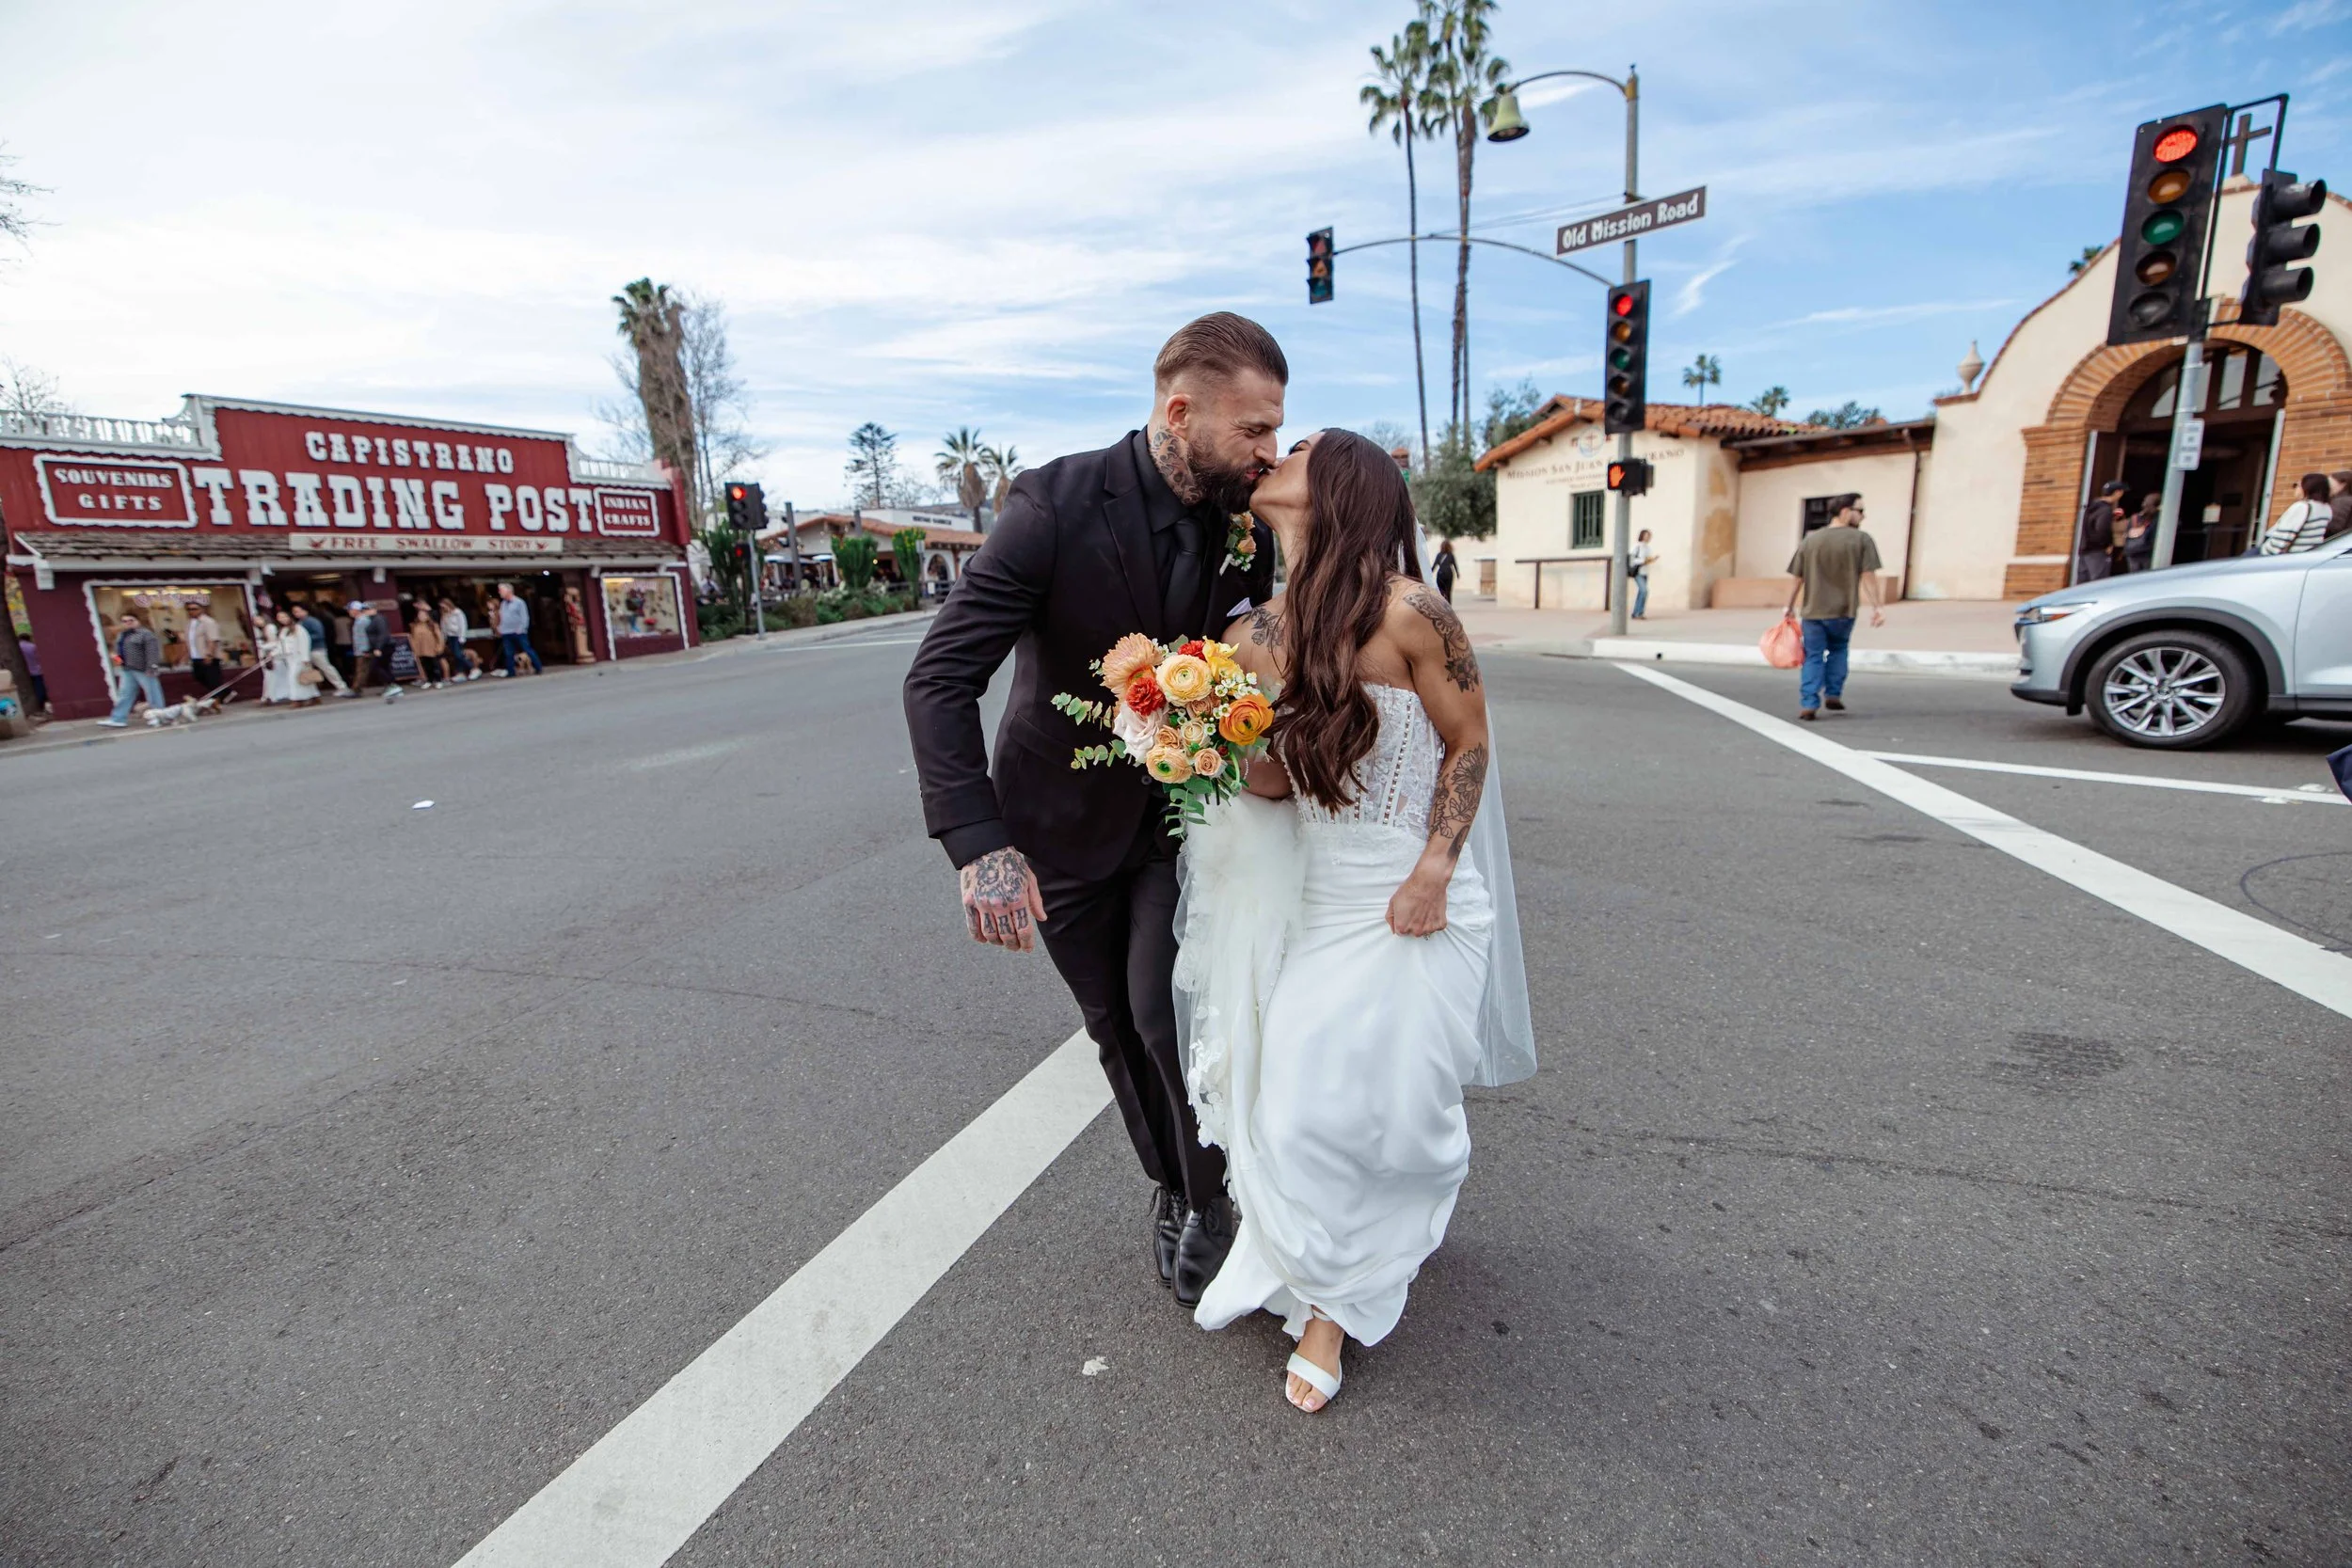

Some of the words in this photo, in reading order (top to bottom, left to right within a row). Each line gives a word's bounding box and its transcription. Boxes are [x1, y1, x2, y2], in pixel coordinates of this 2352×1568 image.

[1562, 224, 1587, 249] Old
[1590, 213, 1653, 242] Mission
[1657, 192, 1699, 224] Road
[305, 431, 514, 474] CAPISTRANO
[54, 467, 173, 488] SOUVENIRS
[78, 493, 163, 511] GIFTS
[192, 467, 465, 530] TRADING
[485, 483, 594, 532] POST
[603, 496, 649, 510] INDIAN
[603, 513, 651, 527] CRAFTS
[330, 536, 380, 549] FREE
[395, 537, 474, 552] SWALLOW
[487, 539, 532, 551] STORY
